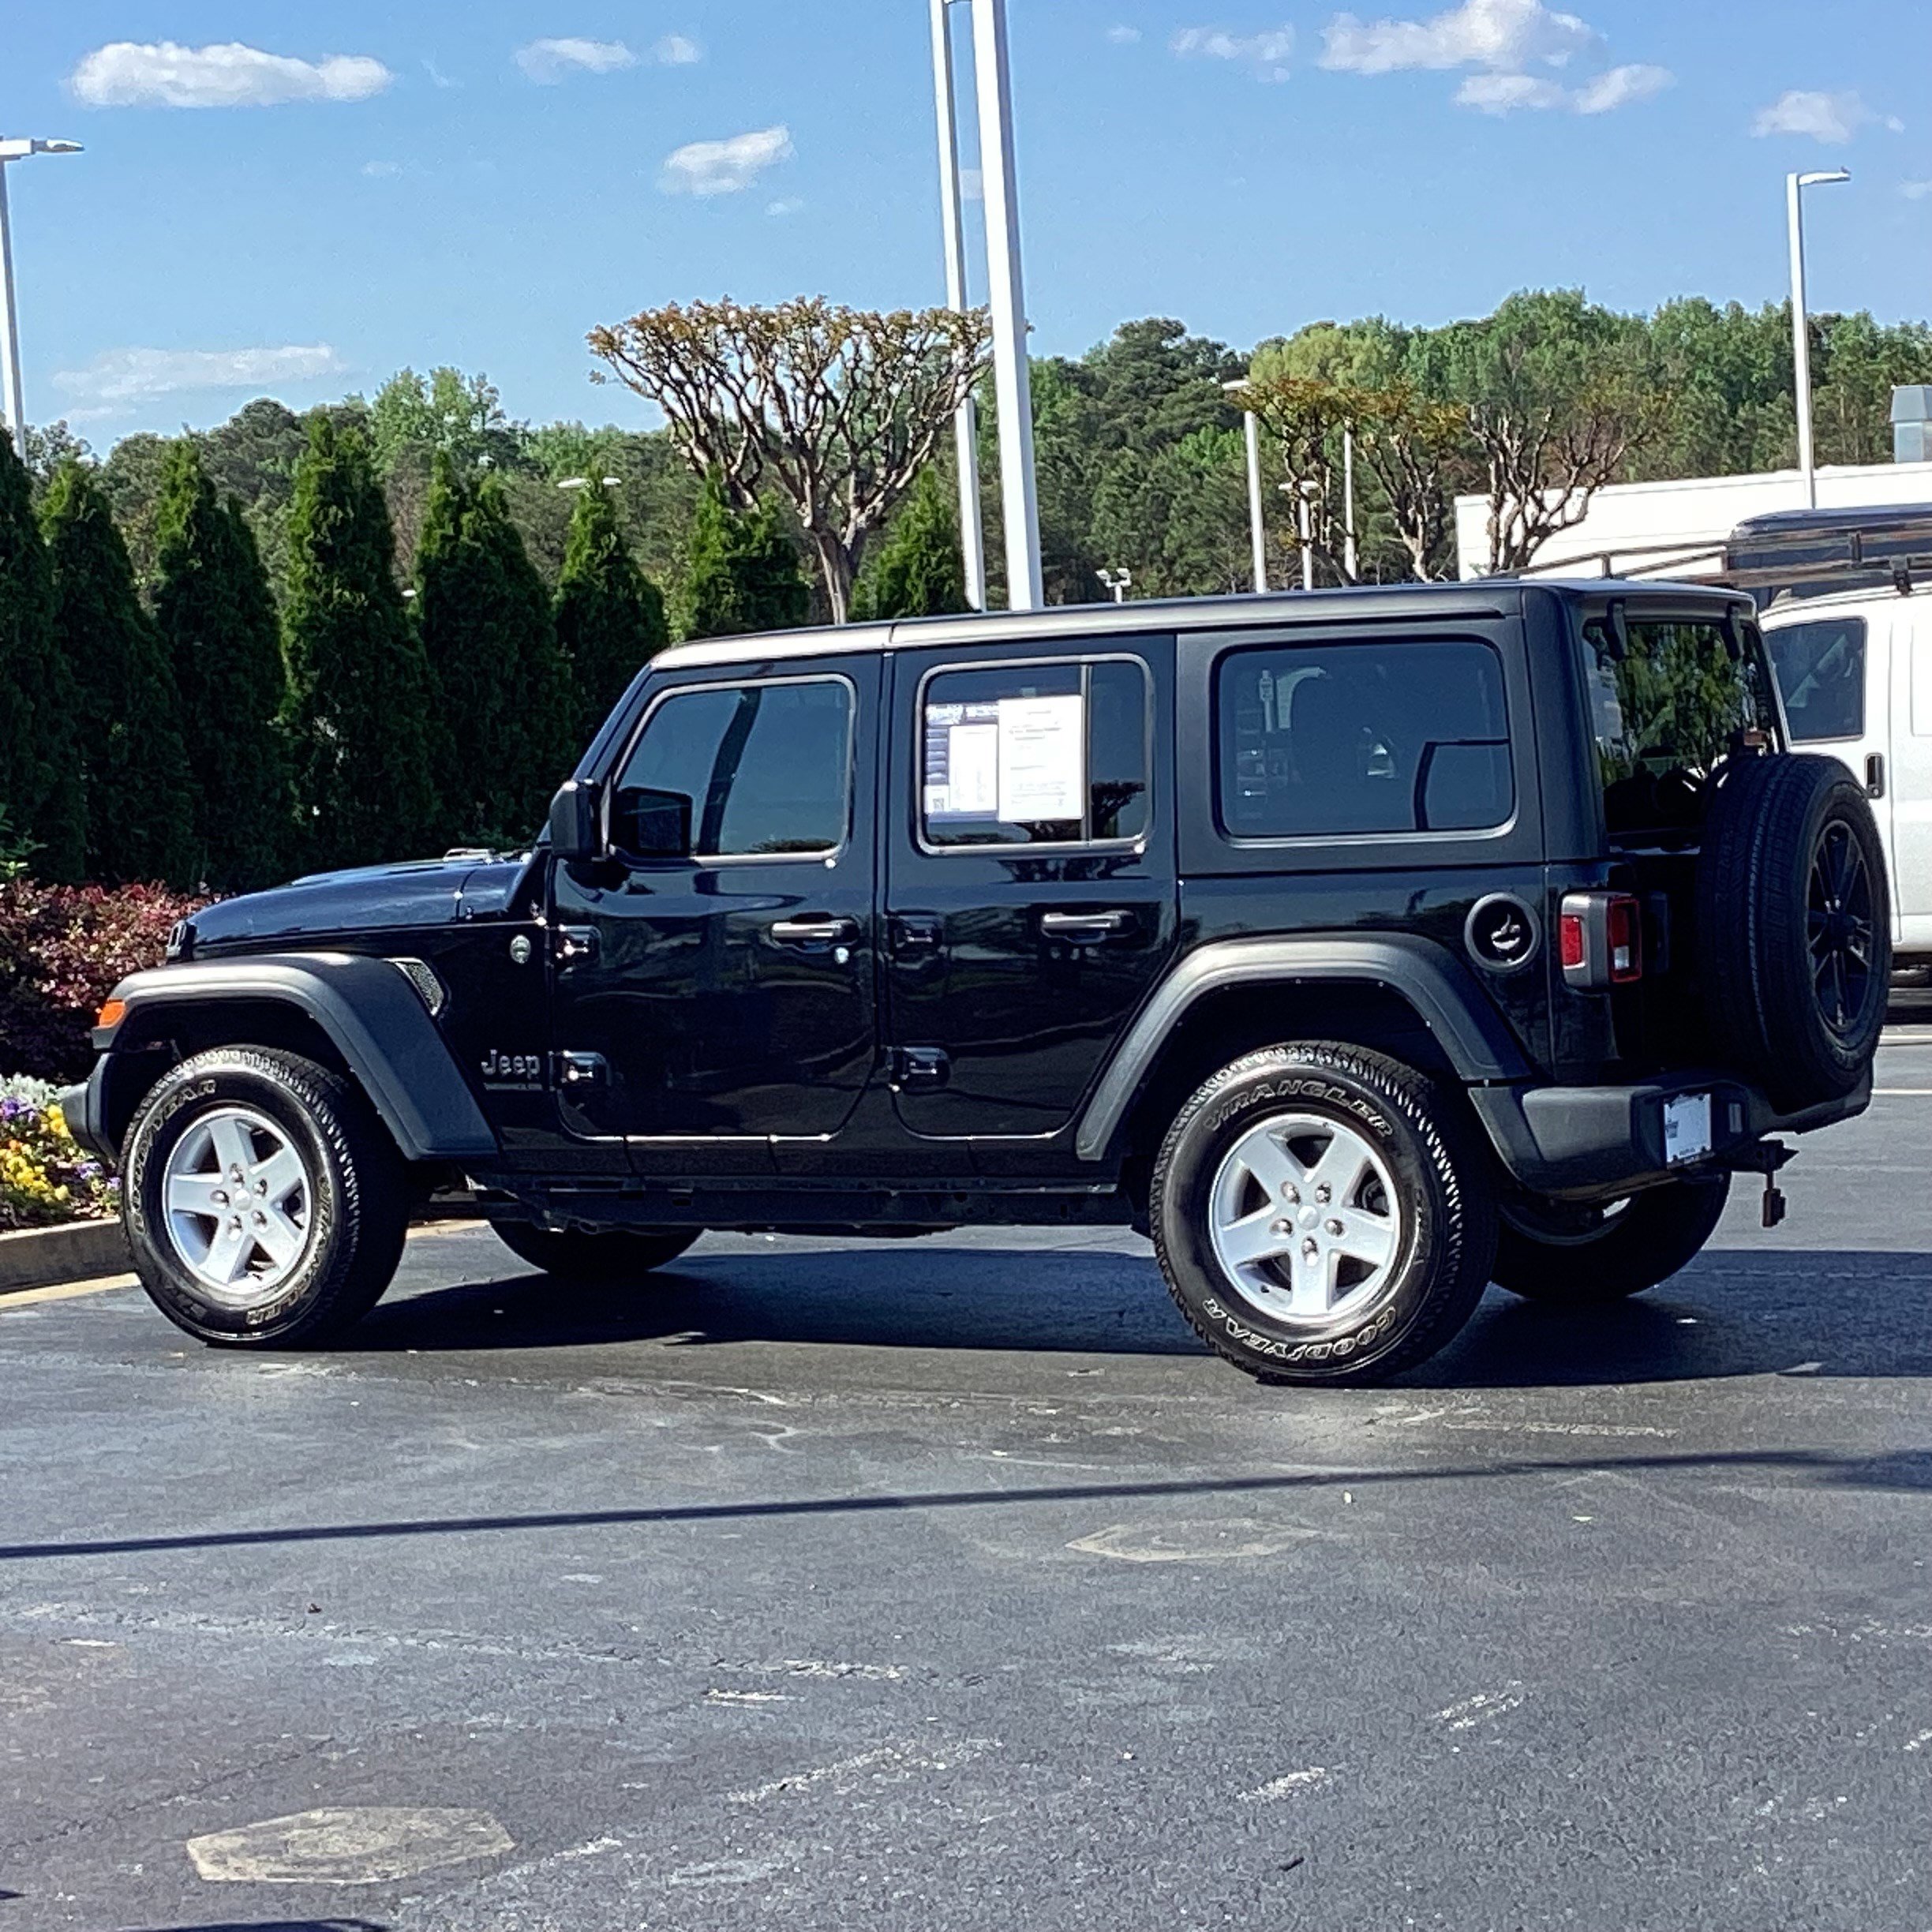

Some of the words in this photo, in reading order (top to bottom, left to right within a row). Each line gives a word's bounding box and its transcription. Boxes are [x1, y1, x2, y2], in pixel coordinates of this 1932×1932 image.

[481, 1049, 541, 1080] Jeep
[1204, 1079, 1394, 1138] WRANGLER
[131, 1079, 217, 1234] GOODYEAR
[1203, 1298, 1396, 1361] GOODYEAR
